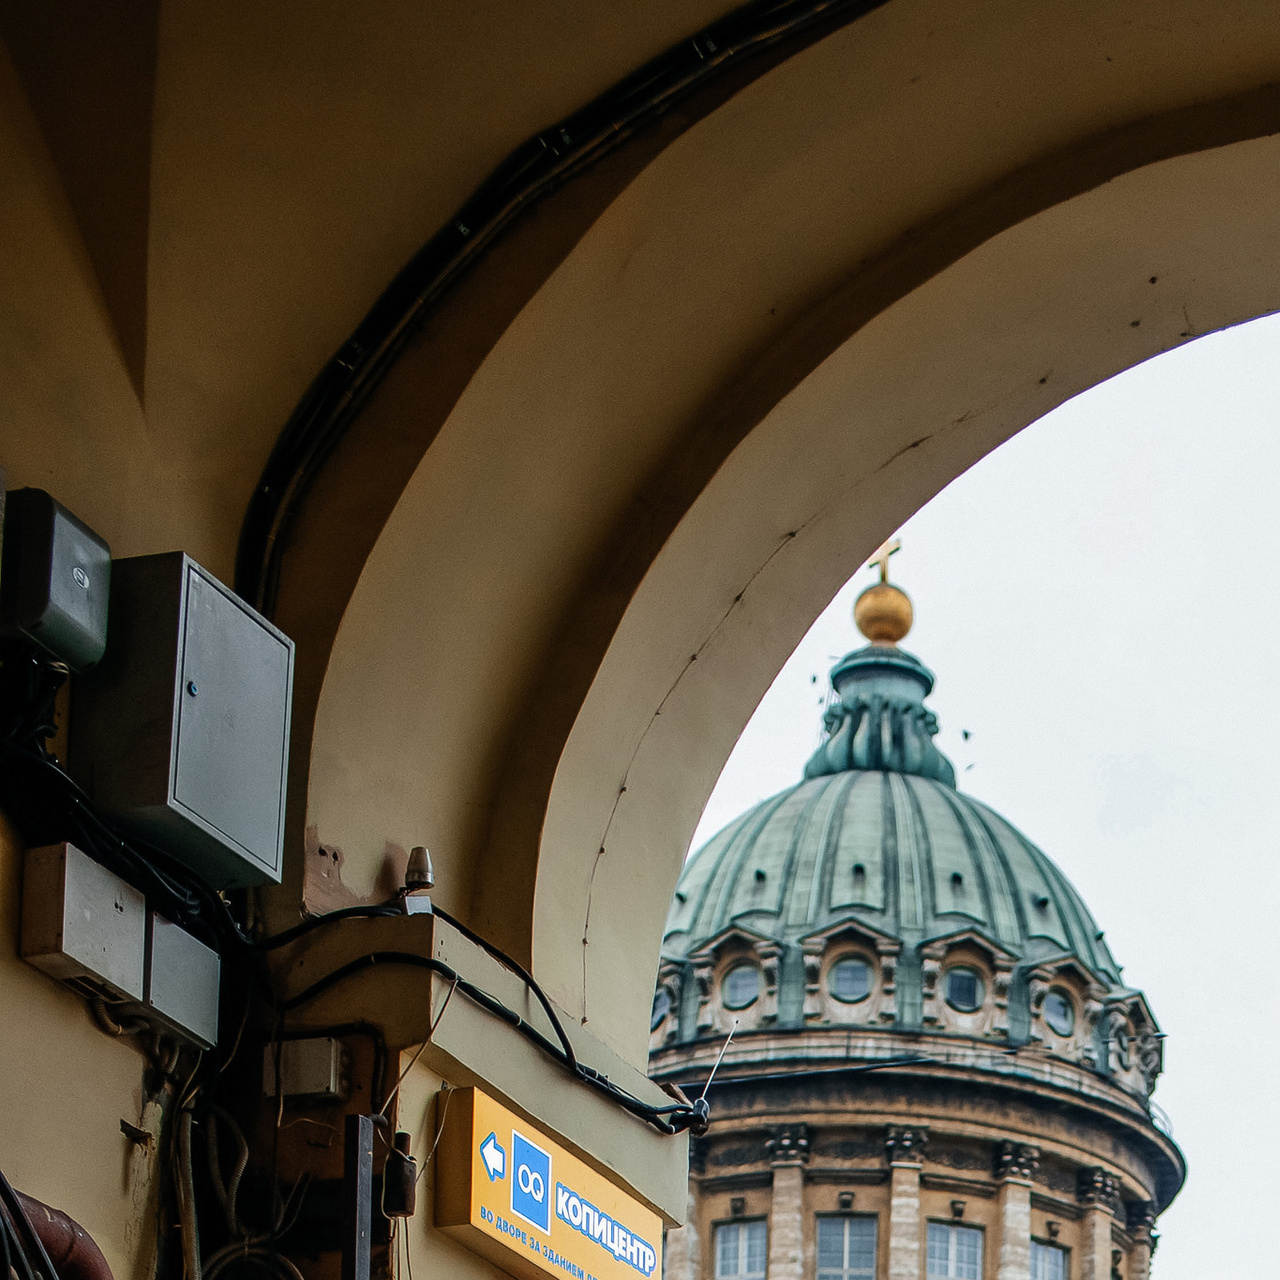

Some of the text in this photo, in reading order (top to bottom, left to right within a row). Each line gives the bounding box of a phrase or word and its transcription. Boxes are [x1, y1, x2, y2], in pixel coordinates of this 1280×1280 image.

[480, 1205, 494, 1224] ВО
[496, 1215, 527, 1245] ДВОРЕ
[529, 1236, 541, 1253] ЗА
[556, 1184, 655, 1275] КОПИЦЕНТР
